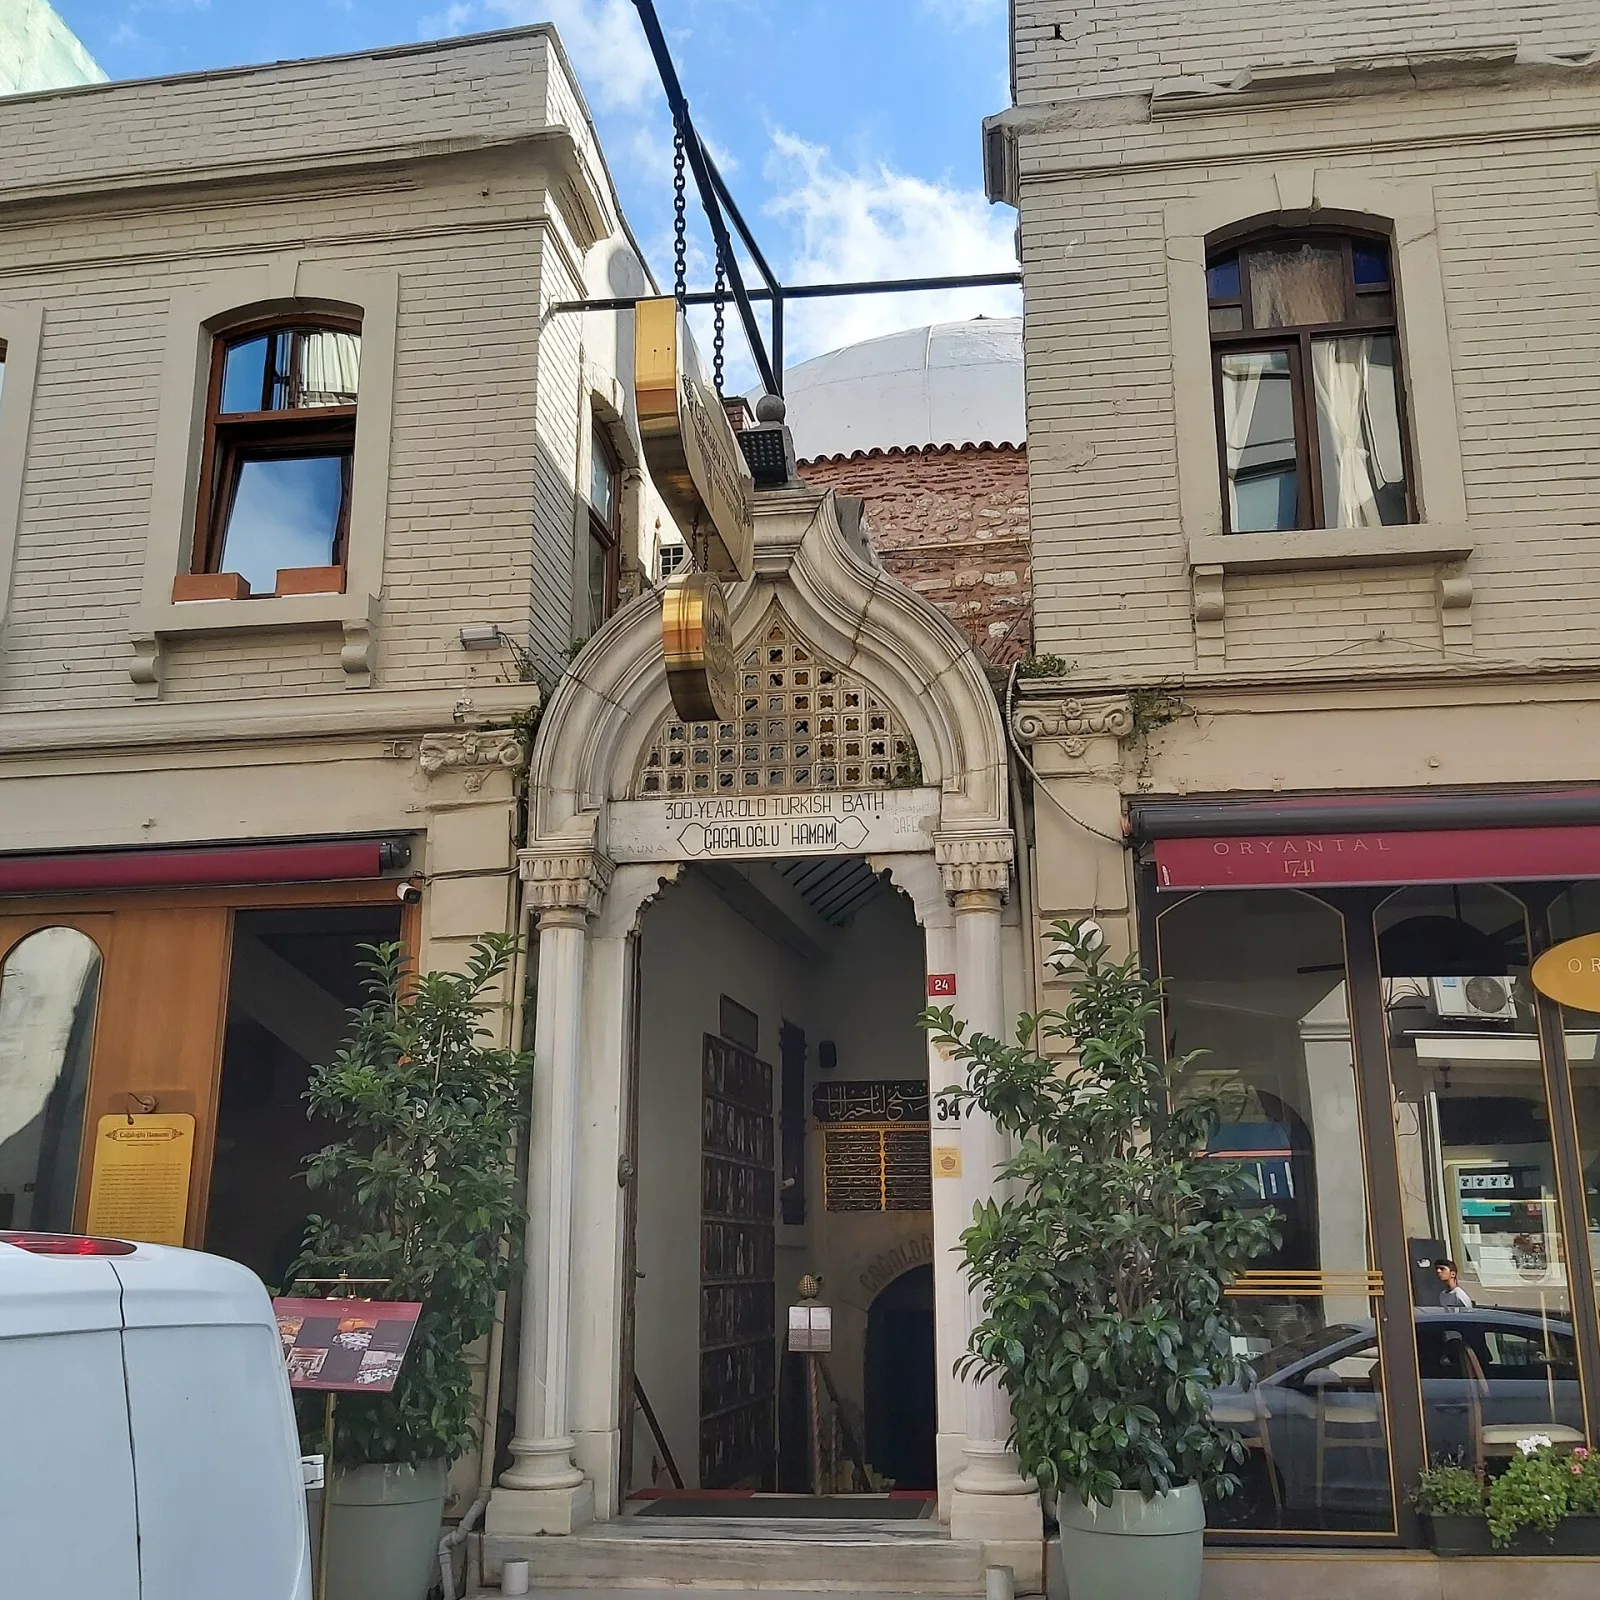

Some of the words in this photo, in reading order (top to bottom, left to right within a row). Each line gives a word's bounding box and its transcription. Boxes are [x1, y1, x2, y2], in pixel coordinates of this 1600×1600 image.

[665, 799, 767, 820] 300-YEAR-OLD
[773, 795, 831, 817] TURKISH
[842, 792, 884, 812] BATH
[704, 823, 780, 850] CAĞALOĞLU
[791, 822, 838, 846] HAMAMI
[1213, 838, 1391, 856] ORYANTAL
[1283, 859, 1315, 877] 1741
[934, 979, 949, 991] 24
[937, 1098, 960, 1121] 34
